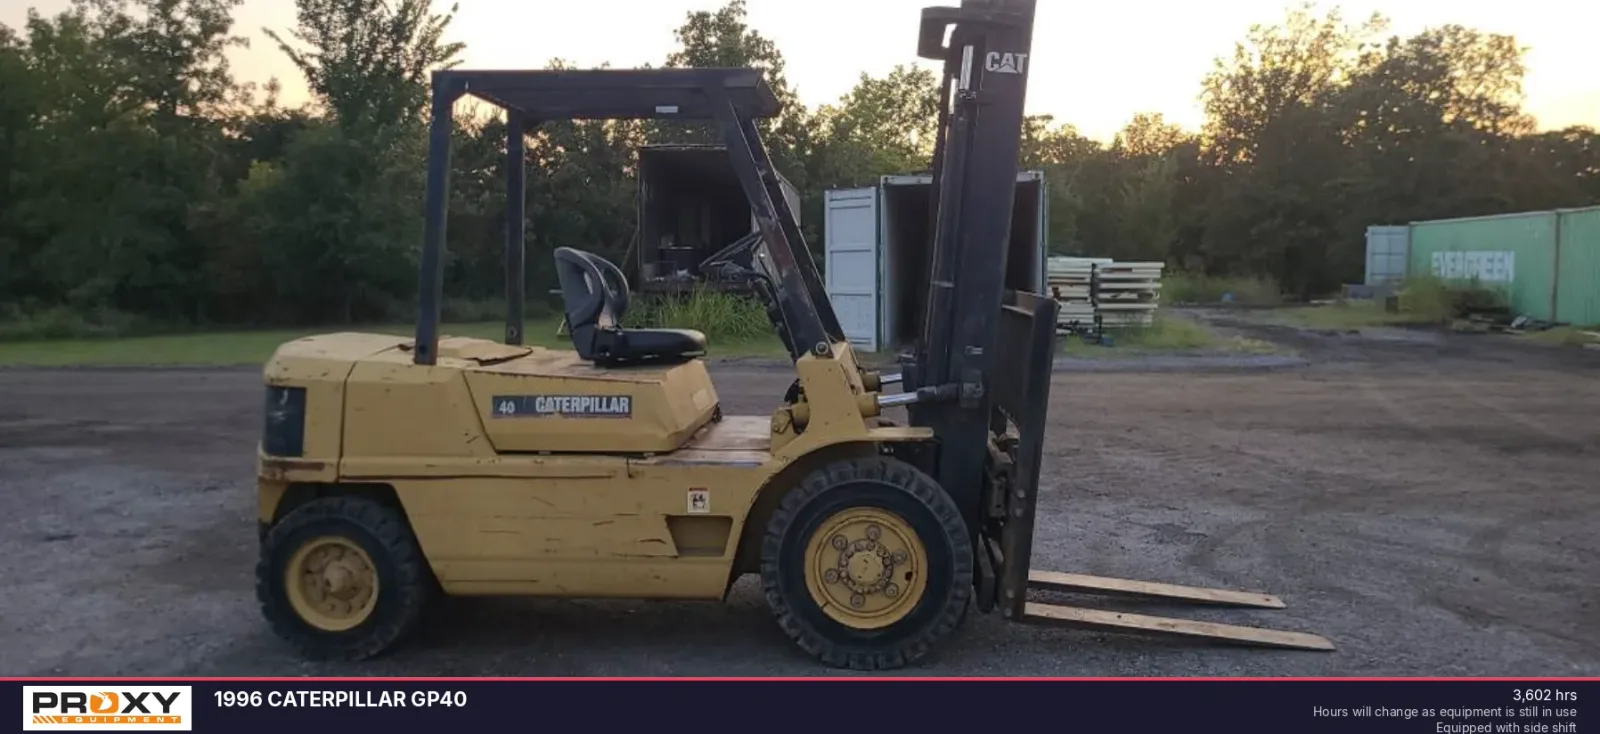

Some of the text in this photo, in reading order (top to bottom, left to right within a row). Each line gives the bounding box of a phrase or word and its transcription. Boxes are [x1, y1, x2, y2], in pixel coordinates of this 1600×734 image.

[985, 51, 1028, 74] CAT
[1431, 250, 1516, 283] EVERGREEN
[499, 397, 629, 413] 40 CATERPILLAR
